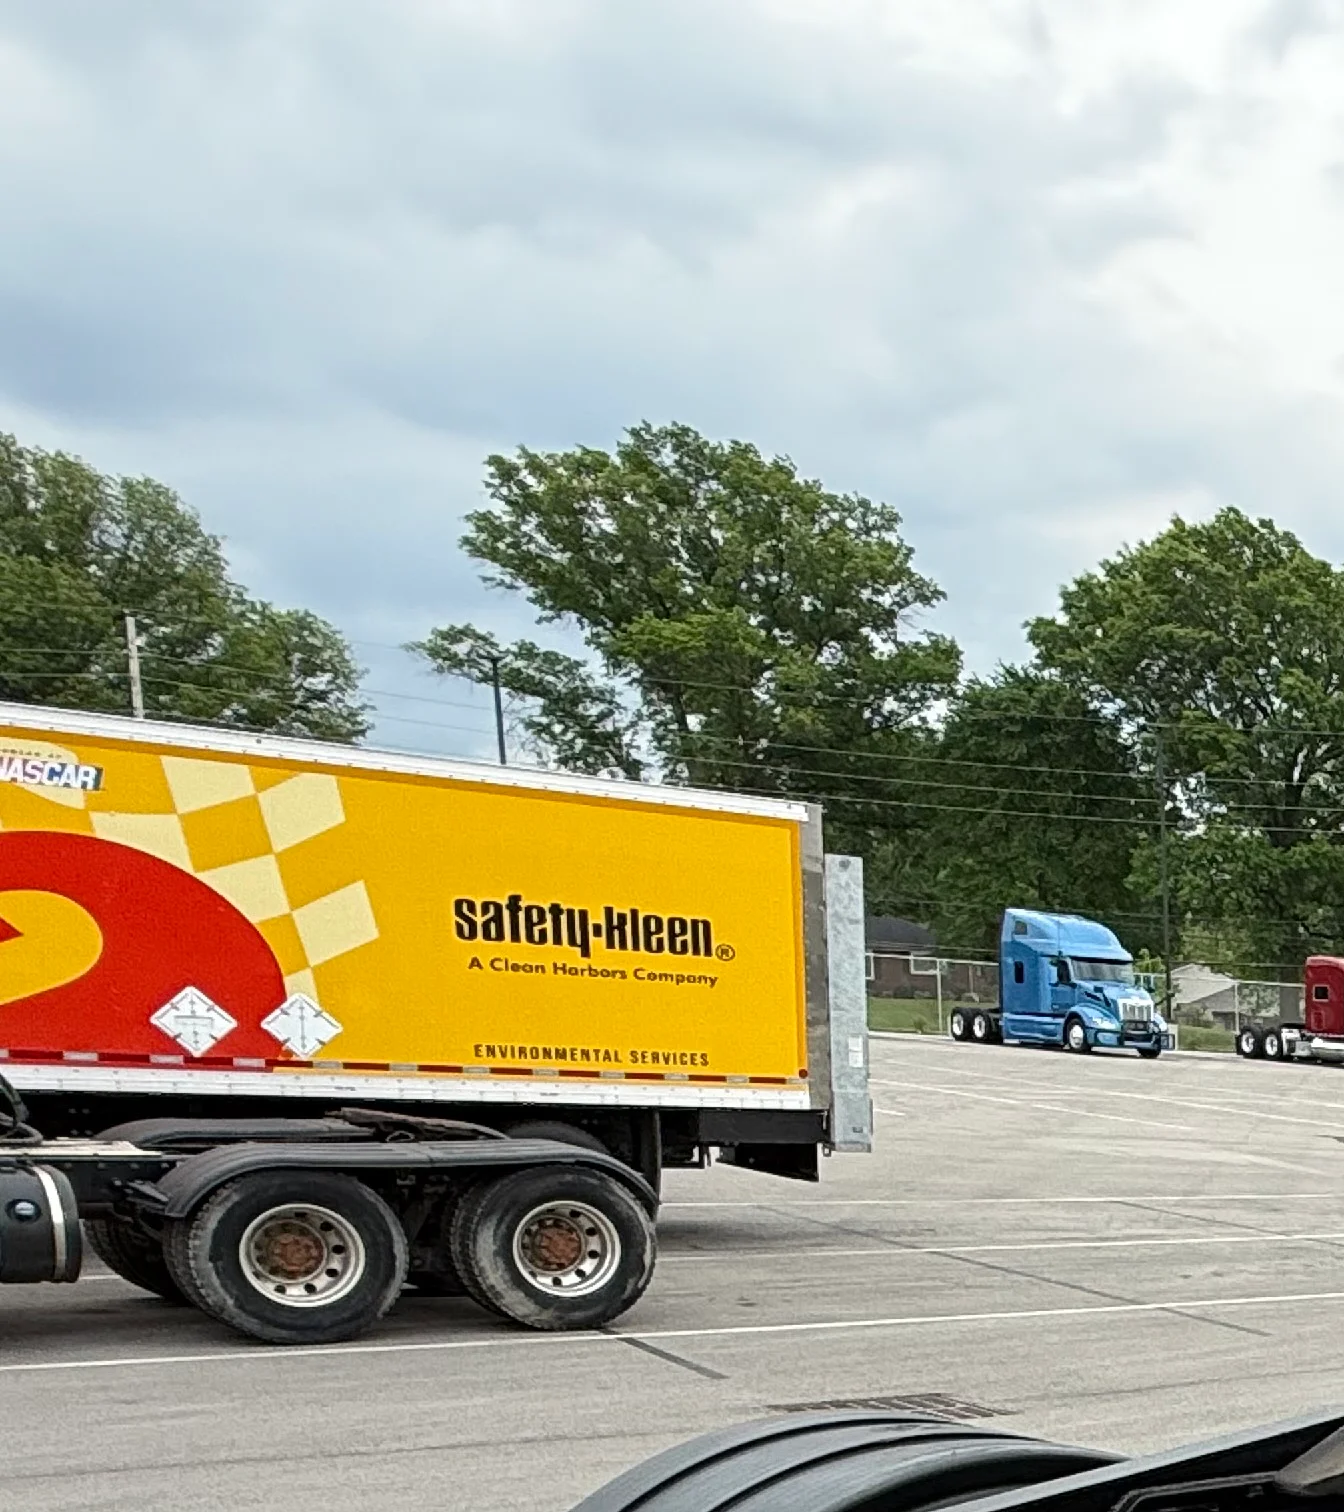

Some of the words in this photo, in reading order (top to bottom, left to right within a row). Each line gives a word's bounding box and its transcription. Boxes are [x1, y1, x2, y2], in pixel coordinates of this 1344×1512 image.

[468, 957, 483, 970] A
[490, 958, 546, 975] Clean
[552, 962, 627, 980] Harbors
[633, 967, 718, 988] Company
[473, 1044, 622, 1063] ENVIRONMENTAL
[629, 1050, 709, 1066] SERVICES
